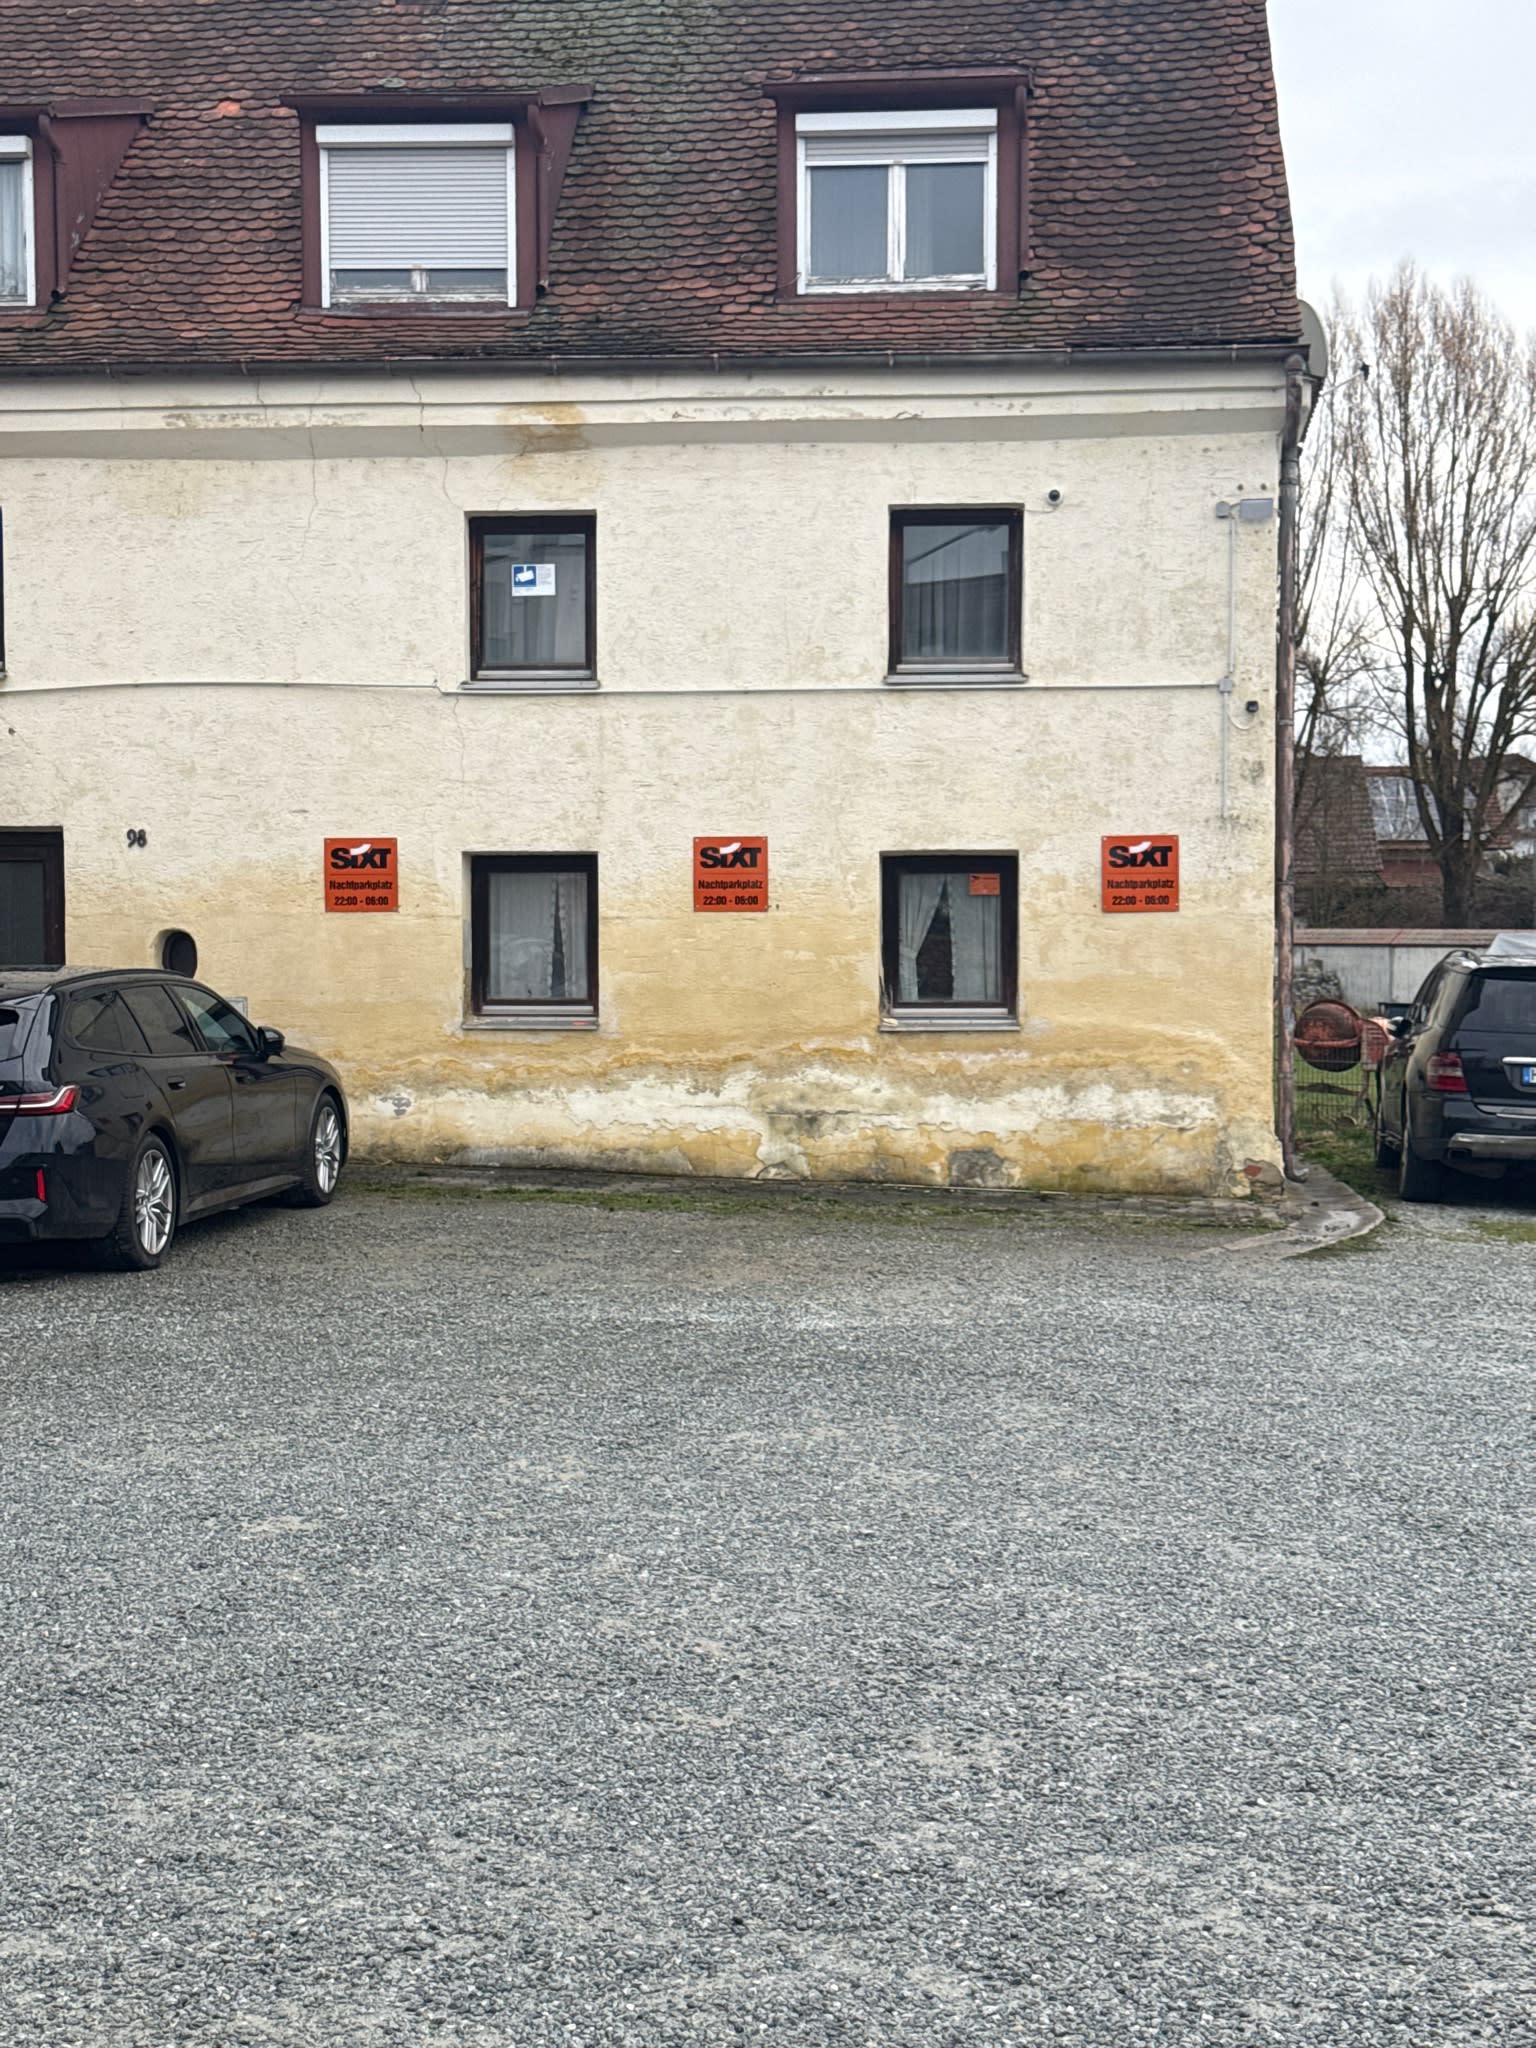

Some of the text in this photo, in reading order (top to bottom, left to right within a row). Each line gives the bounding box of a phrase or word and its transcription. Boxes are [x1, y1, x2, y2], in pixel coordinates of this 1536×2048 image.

[126, 828, 148, 849] 98
[329, 880, 393, 891] Nachtparkplatz
[698, 879, 763, 890] Nachtparkplatz
[1107, 879, 1175, 890] Nachtparkplatz
[334, 896, 358, 906] 22:00
[703, 895, 727, 906] 22:00
[1112, 895, 1137, 906] 22:00
